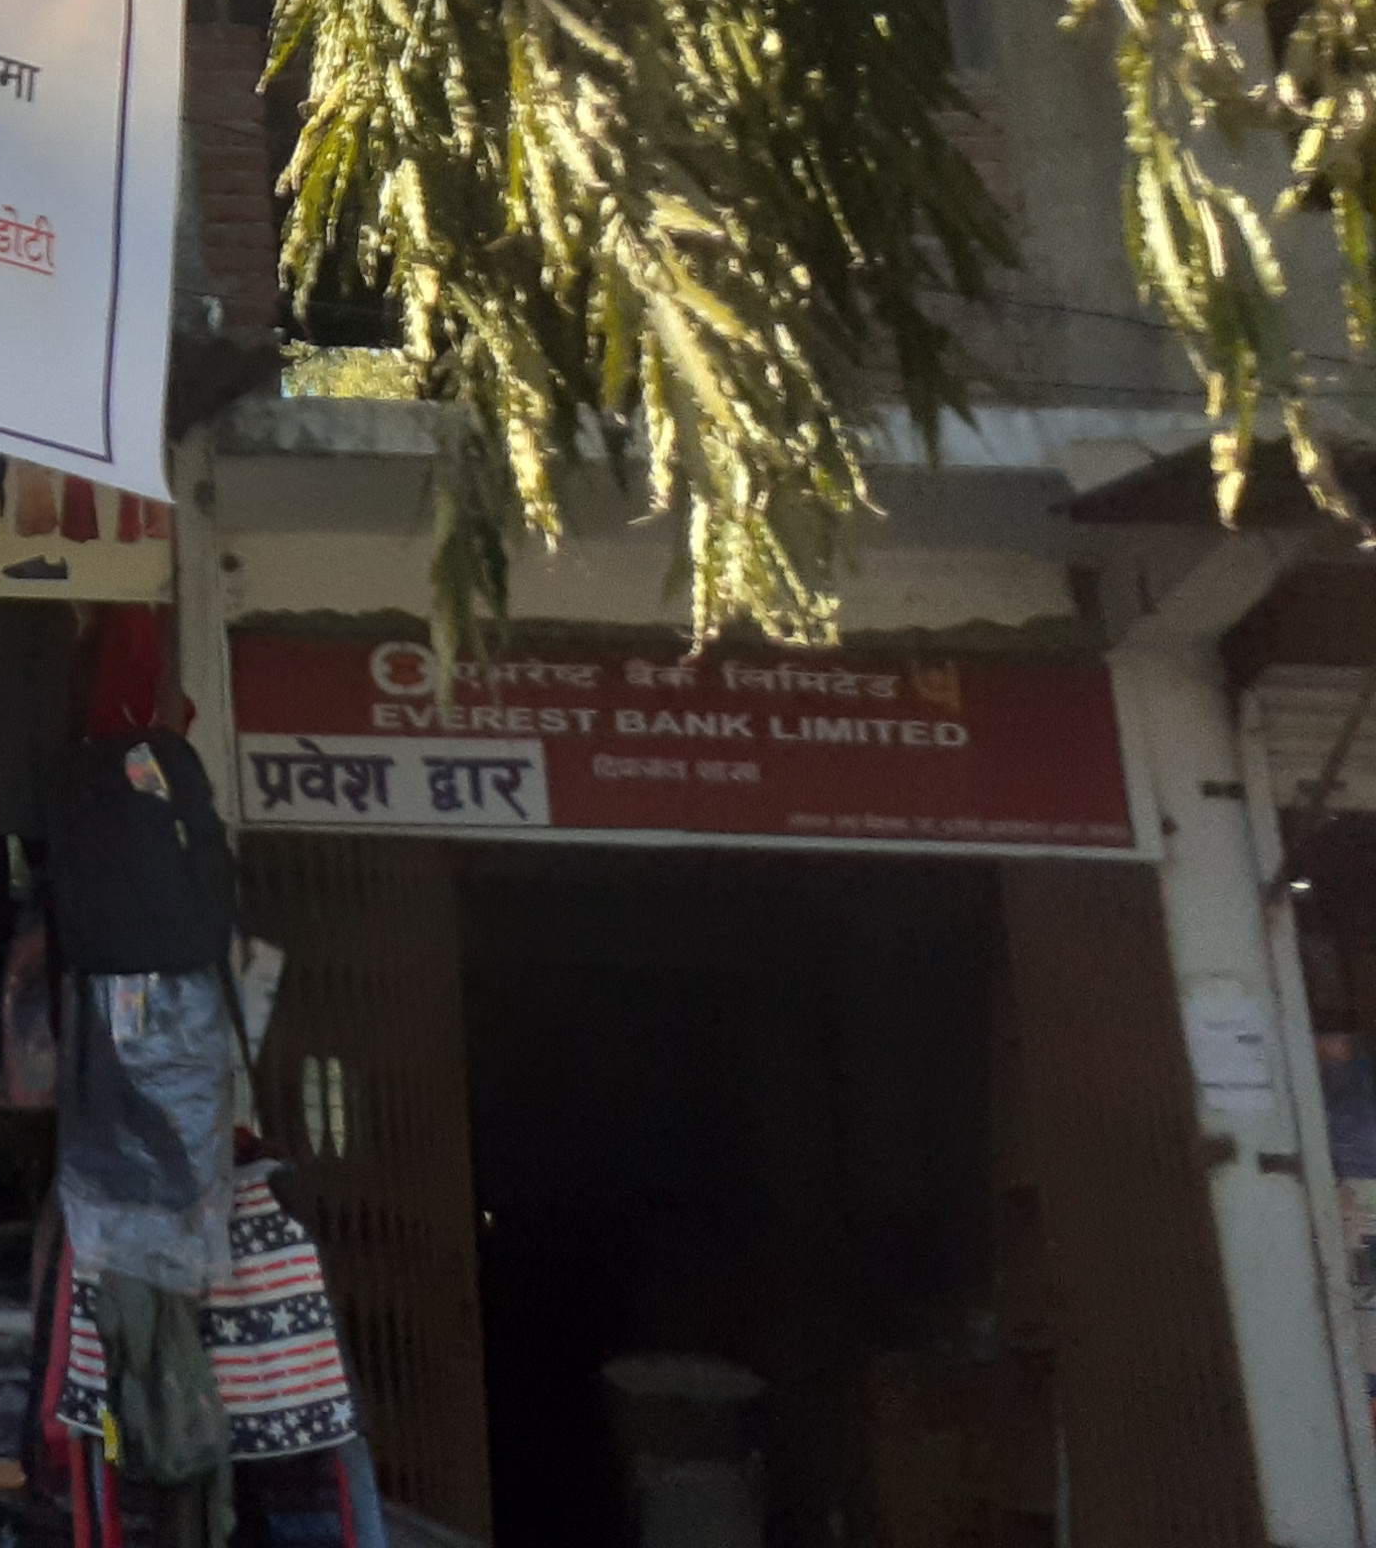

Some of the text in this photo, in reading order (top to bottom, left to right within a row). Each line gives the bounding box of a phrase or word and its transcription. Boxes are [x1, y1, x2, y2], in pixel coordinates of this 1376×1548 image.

[372, 702, 969, 748] EVEREST BANK LIMITED
[251, 736, 533, 822] प्रवेश द्वार
